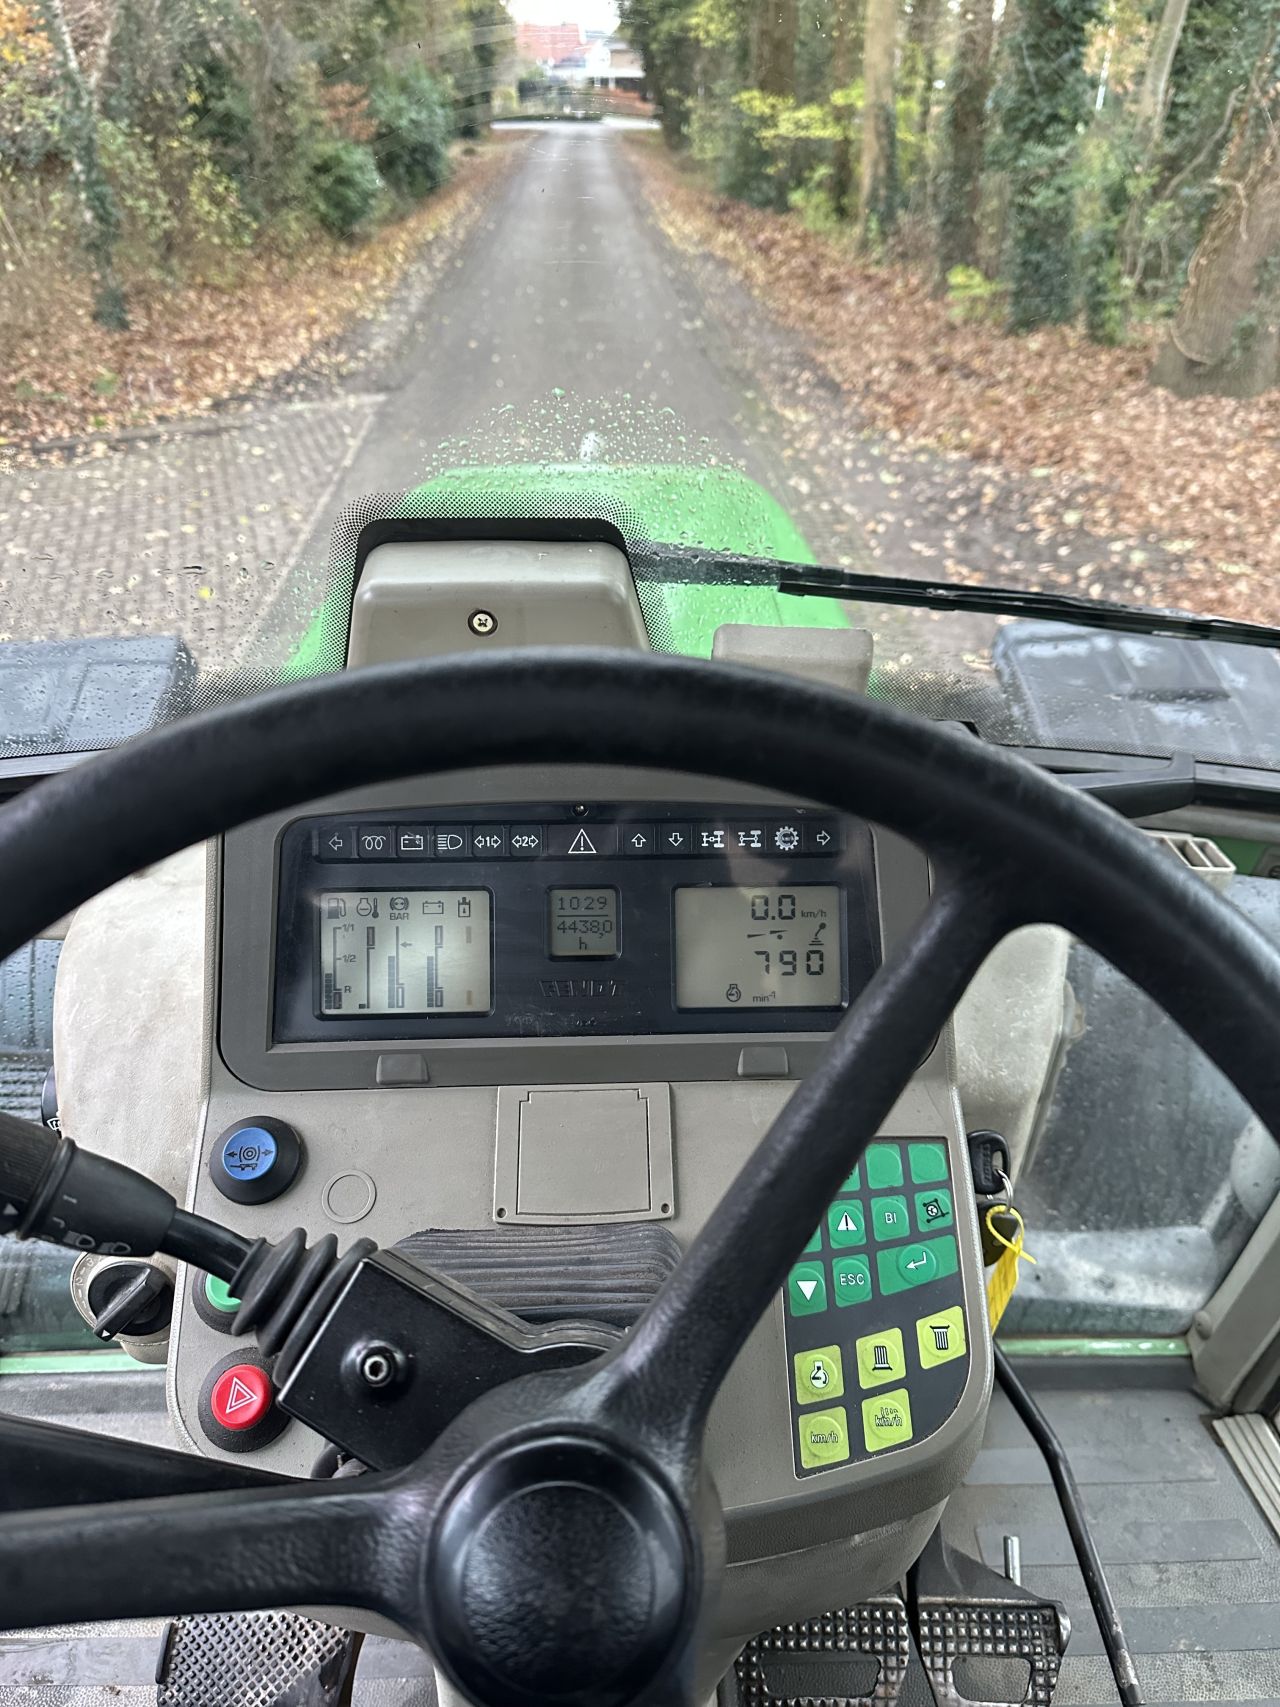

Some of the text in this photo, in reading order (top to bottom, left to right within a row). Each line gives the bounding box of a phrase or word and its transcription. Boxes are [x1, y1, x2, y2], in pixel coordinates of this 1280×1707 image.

[485, 836, 491, 847] 1
[521, 835, 529, 847] 2
[751, 894, 827, 921] 0.0 km/h
[389, 912, 409, 921] BAR
[342, 923, 355, 931] 1/1
[578, 937, 588, 950] h
[342, 954, 356, 963] 1/2
[753, 949, 825, 976] 790
[344, 985, 352, 993] R
[840, 1273, 865, 1286] ESC
[810, 1431, 839, 1444] km/h
